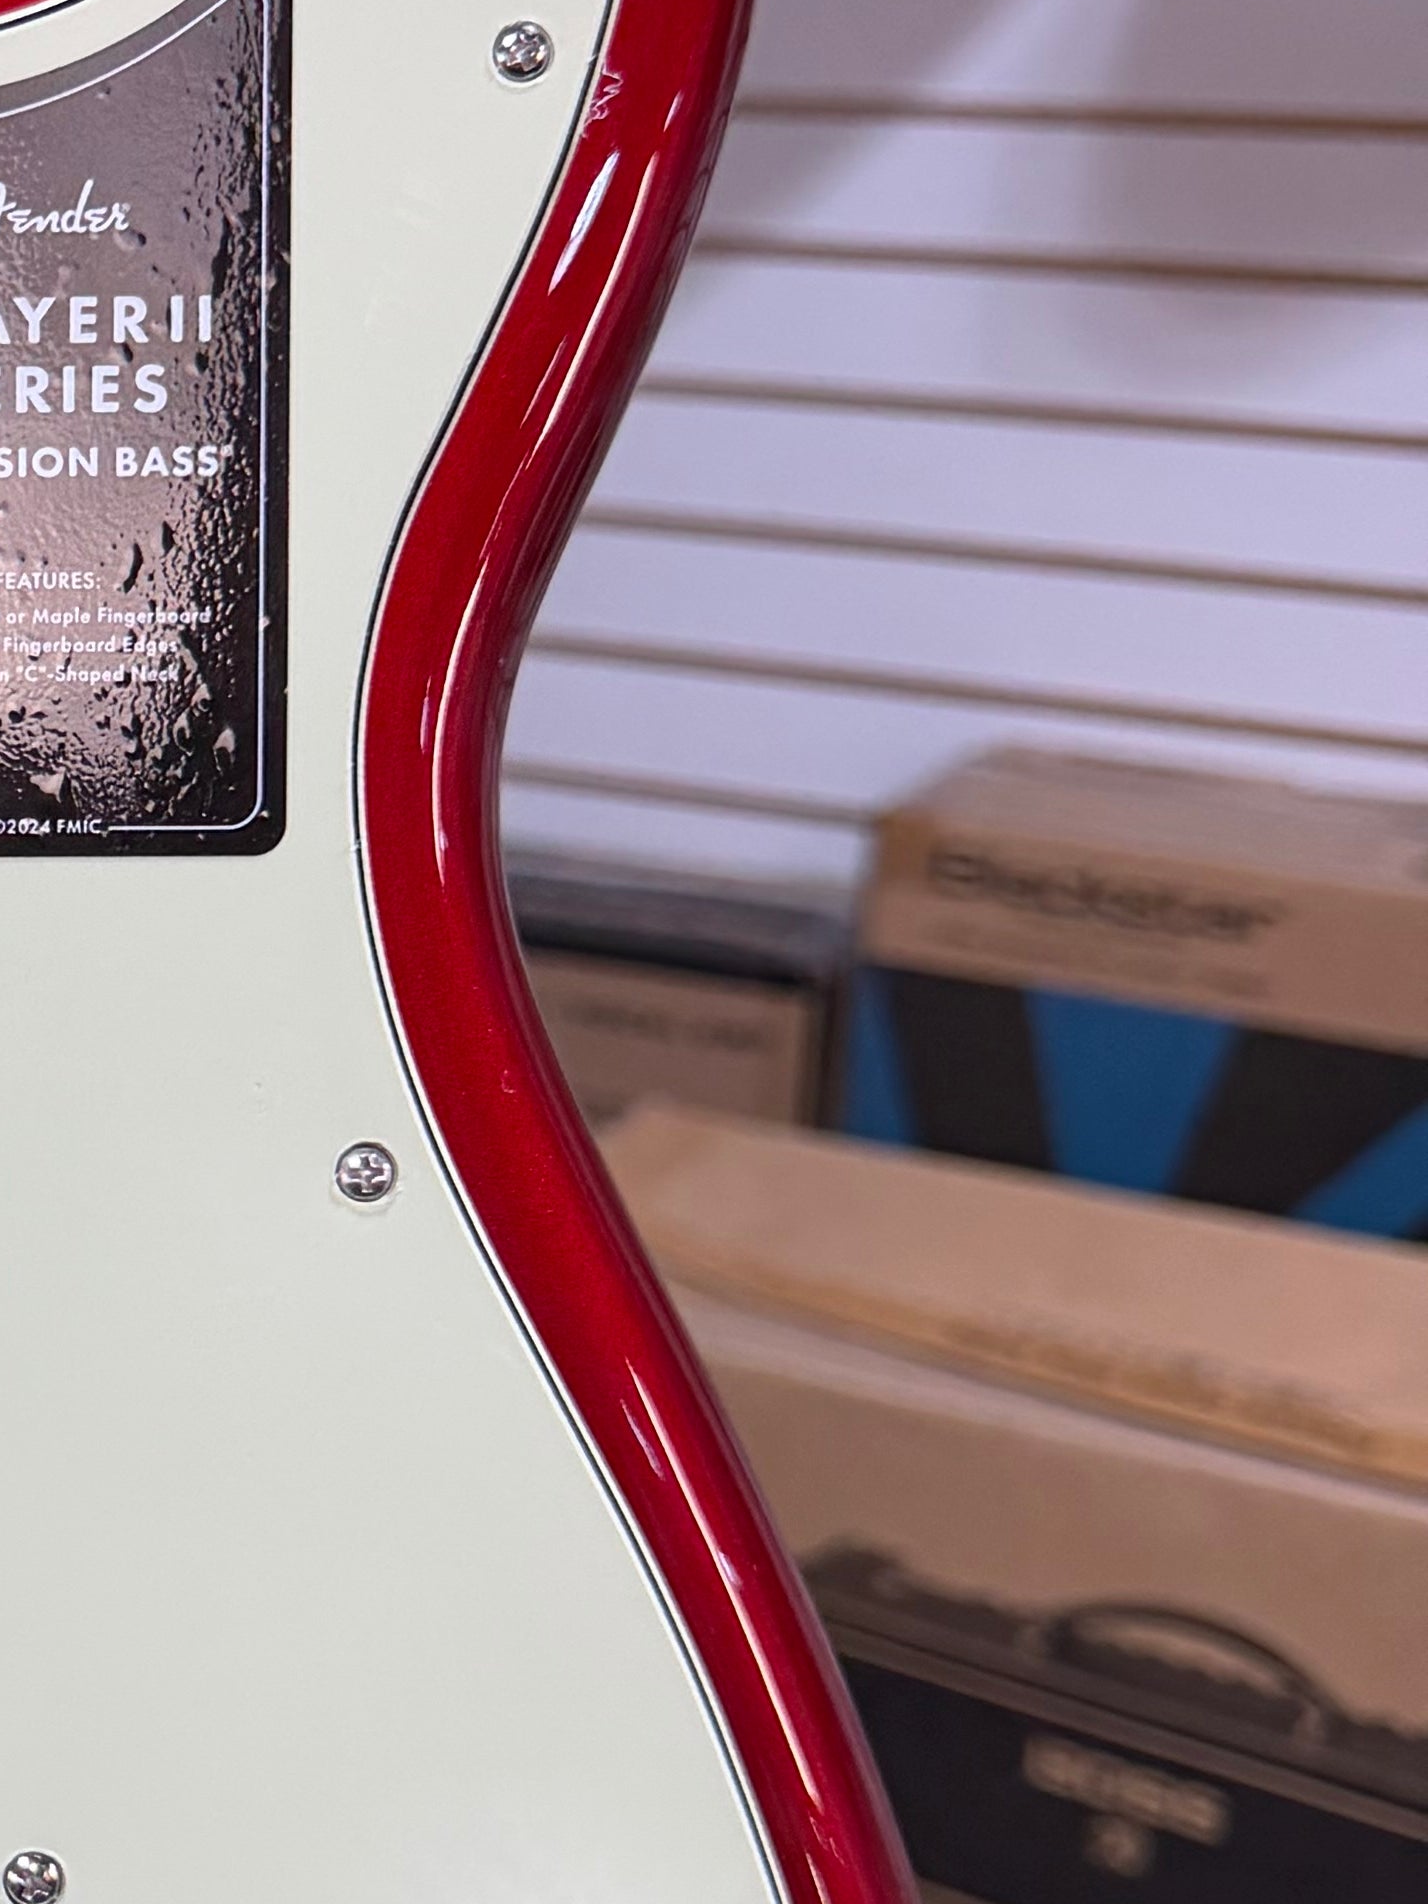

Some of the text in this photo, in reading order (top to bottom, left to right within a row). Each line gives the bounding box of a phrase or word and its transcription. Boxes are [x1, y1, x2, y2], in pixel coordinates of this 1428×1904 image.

[170, 294, 212, 343] II
[5, 611, 25, 625] or
[32, 607, 91, 630] Maple
[97, 606, 212, 630] Fingerboard
[3, 636, 116, 659] Fingerboard
[123, 636, 178, 658] Edges
[131, 665, 179, 684] Neck
[57, 818, 102, 834] FMIC
